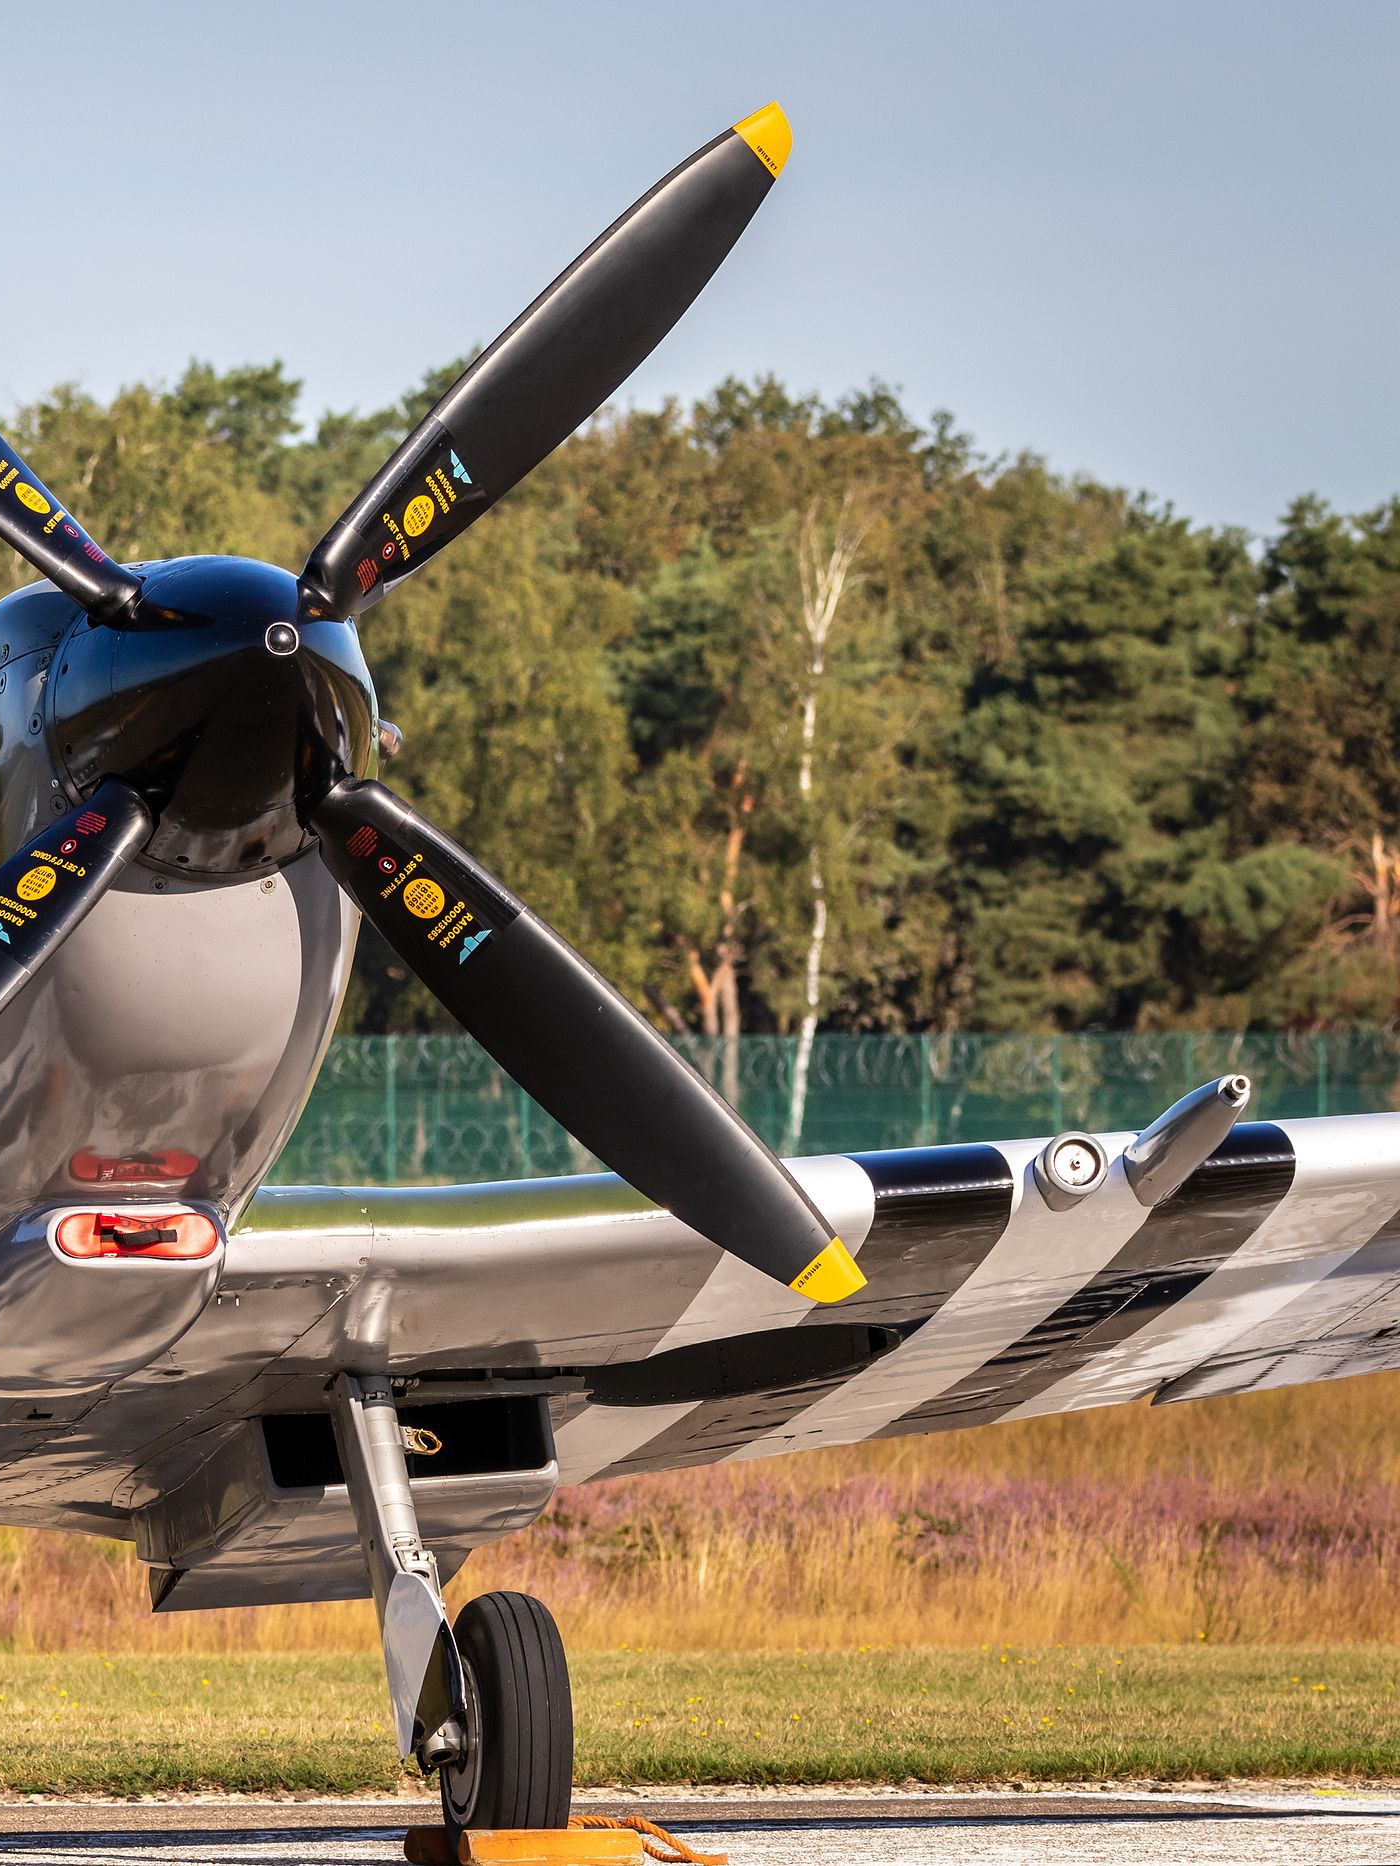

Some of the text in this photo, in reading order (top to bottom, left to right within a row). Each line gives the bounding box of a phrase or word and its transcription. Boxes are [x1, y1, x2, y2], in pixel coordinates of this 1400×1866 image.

[435, 468, 457, 502] RA10046
[383, 513, 390, 524] Q
[387, 519, 399, 534] SET
[385, 546, 392, 555] 2
[413, 854, 423, 862] Q
[61, 861, 78, 872] SET
[383, 861, 392, 869] 3
[404, 860, 417, 875] SET
[77, 867, 86, 877] Q
[380, 882, 397, 899] FINE
[439, 912, 474, 948] RA10046
